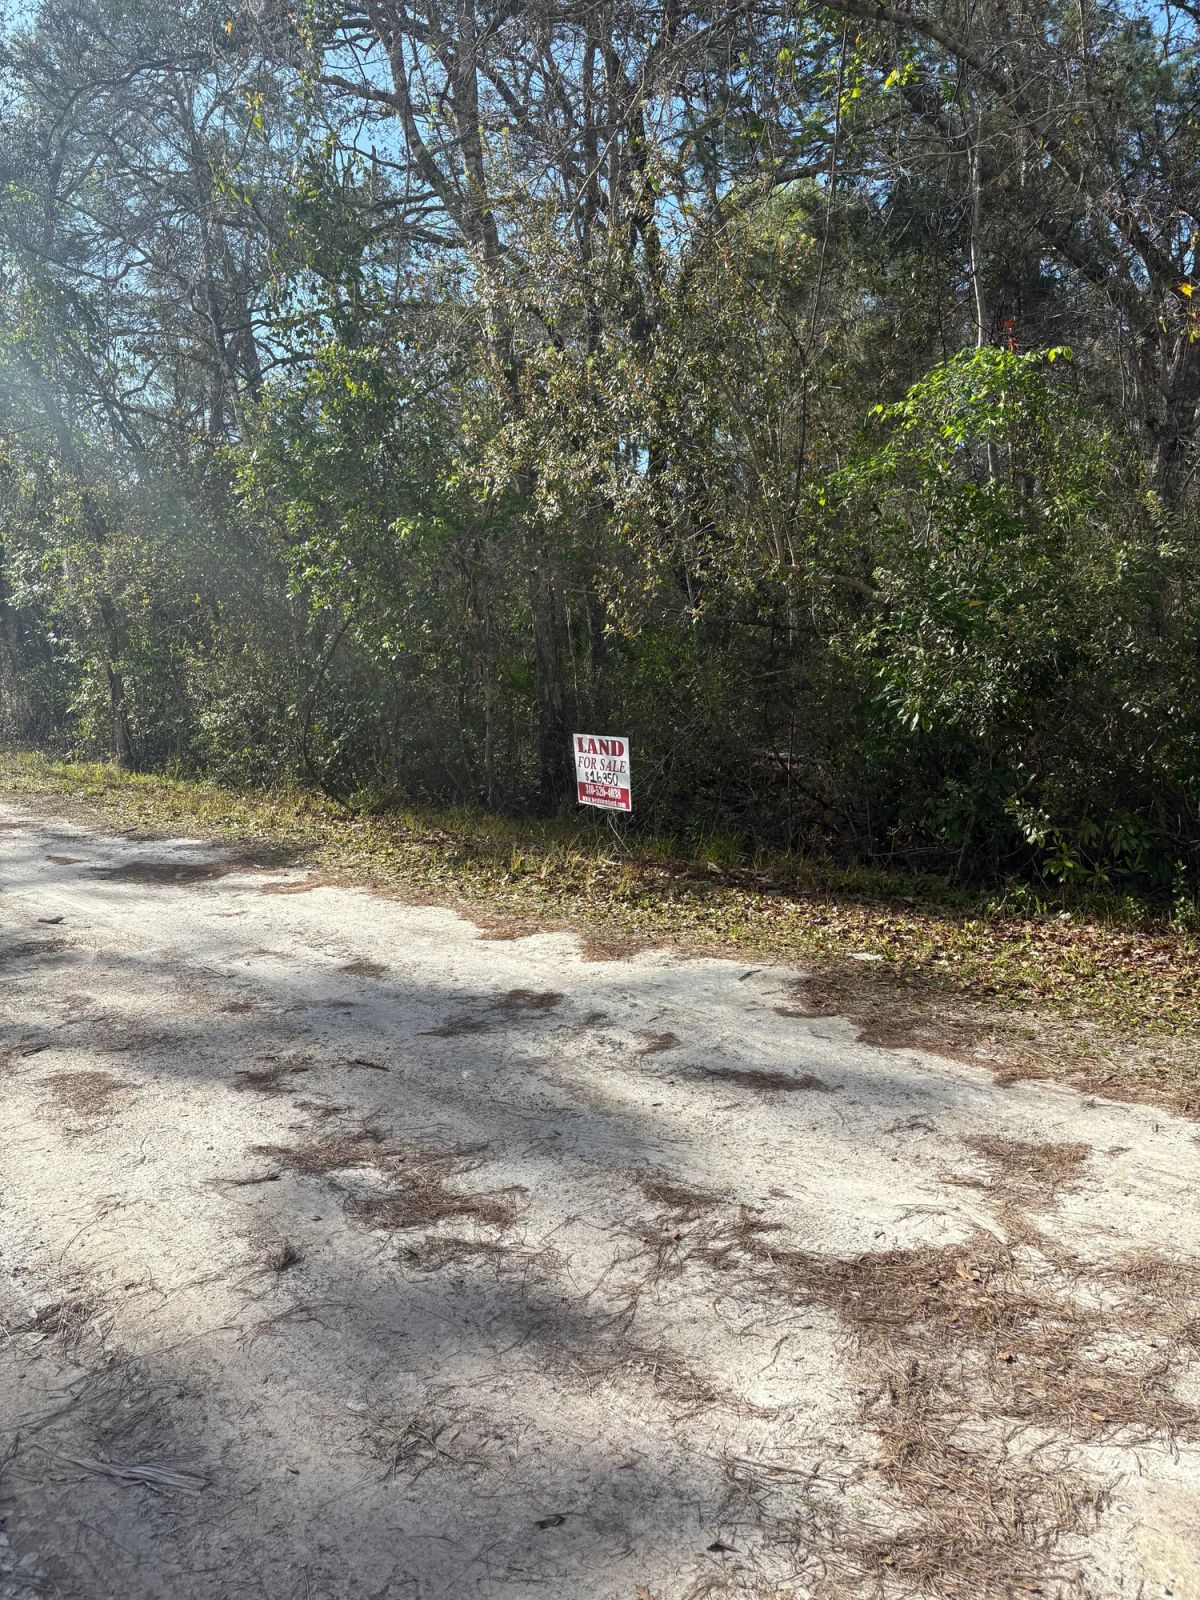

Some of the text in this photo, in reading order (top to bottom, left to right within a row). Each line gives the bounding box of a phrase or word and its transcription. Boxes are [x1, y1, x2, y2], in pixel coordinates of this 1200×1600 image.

[577, 737, 624, 756] LAND
[578, 756, 626, 773] FOR SALE
